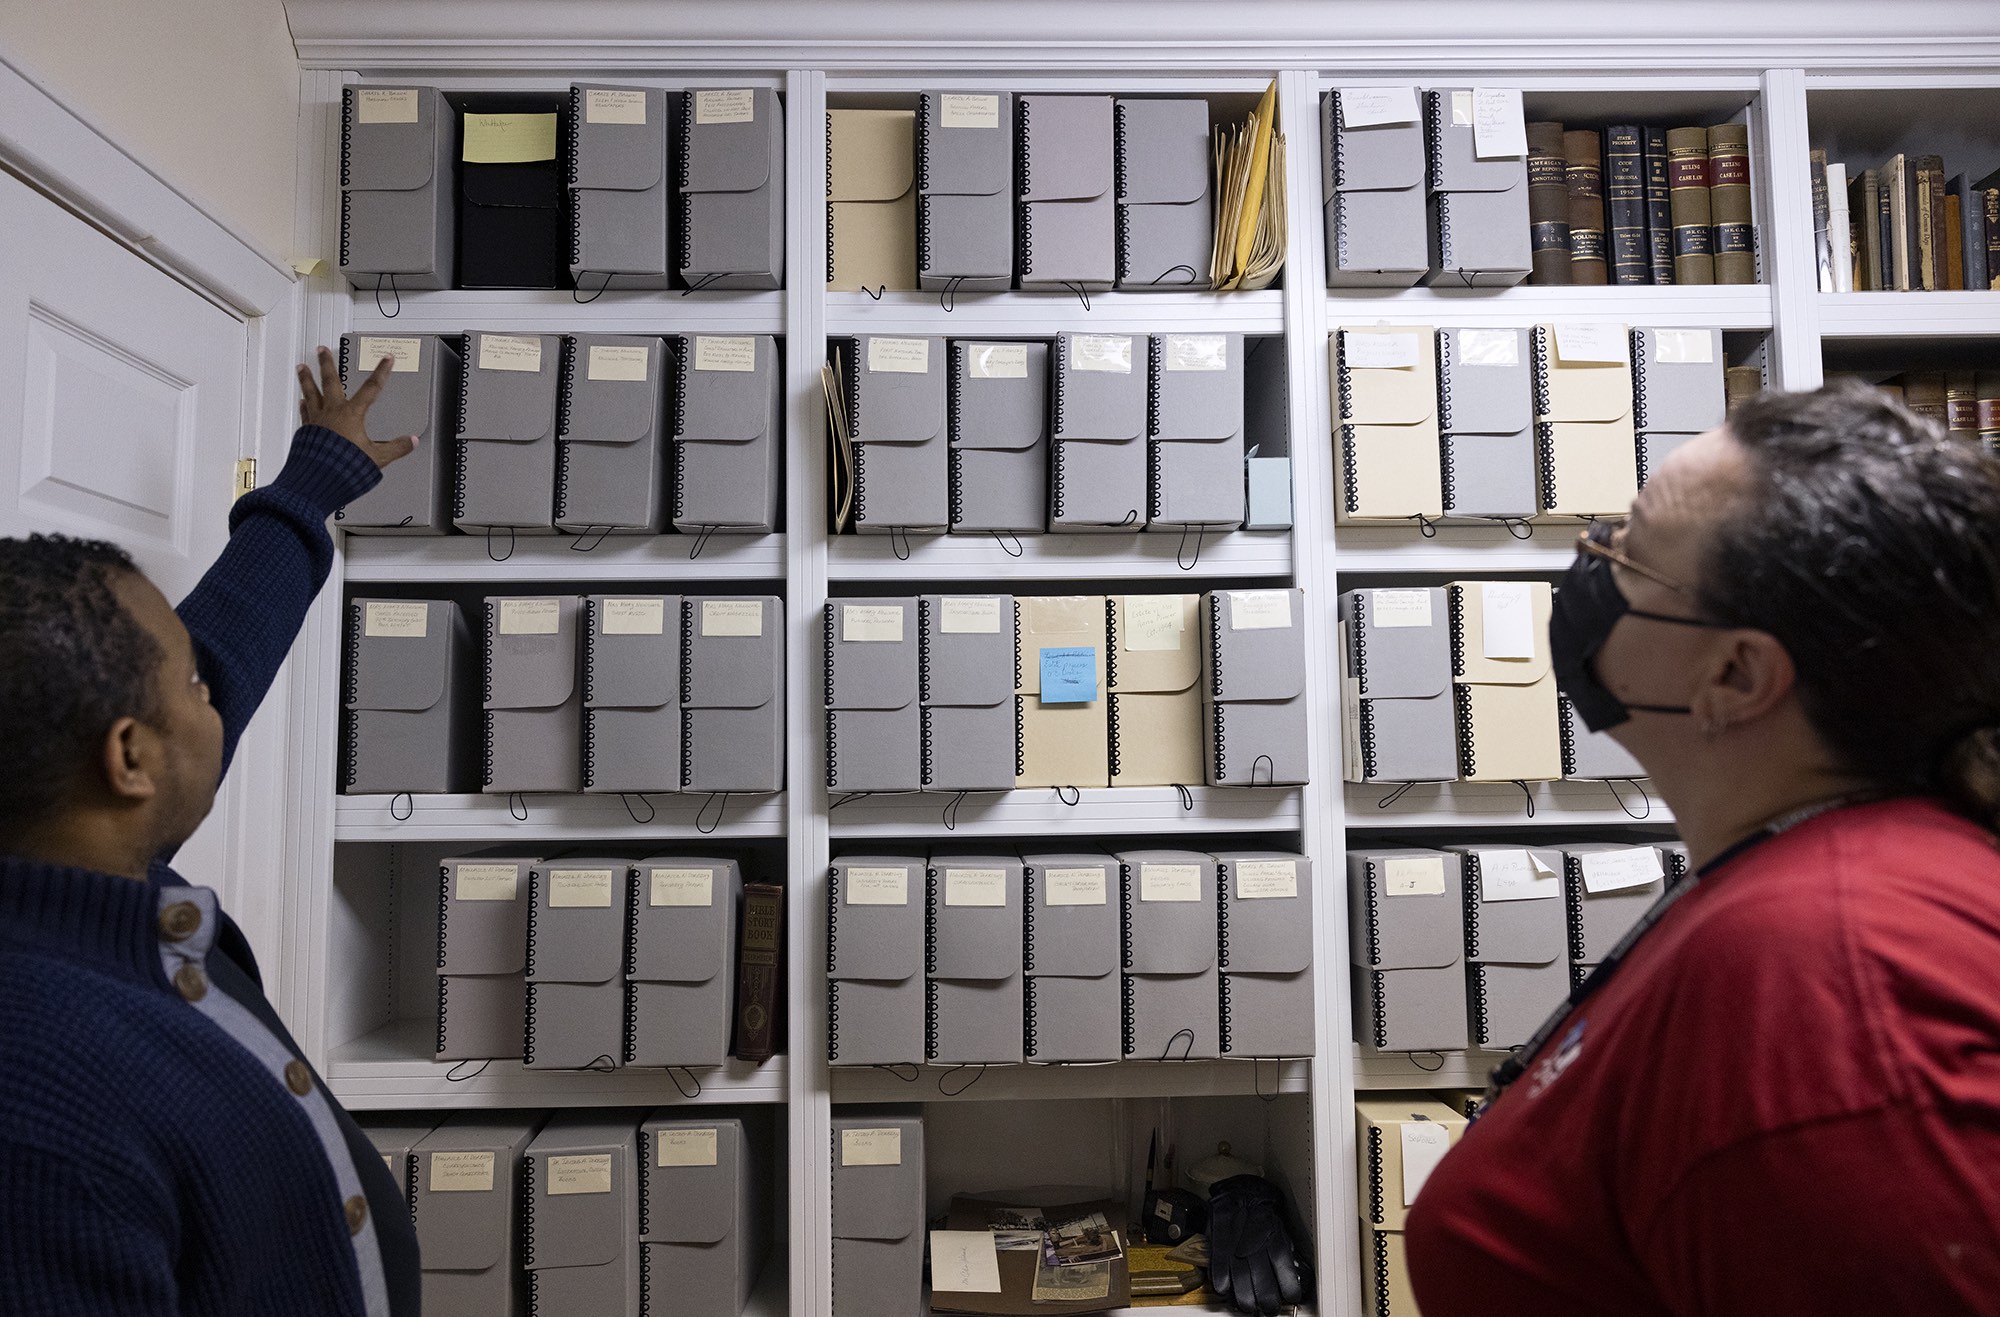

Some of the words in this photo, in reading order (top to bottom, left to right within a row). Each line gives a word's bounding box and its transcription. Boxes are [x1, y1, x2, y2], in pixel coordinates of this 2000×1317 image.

[1680, 163, 1701, 171] RULING
[748, 904, 775, 915] BIBLE
[747, 917, 775, 928] STORY
[747, 929, 774, 940] BOOK
